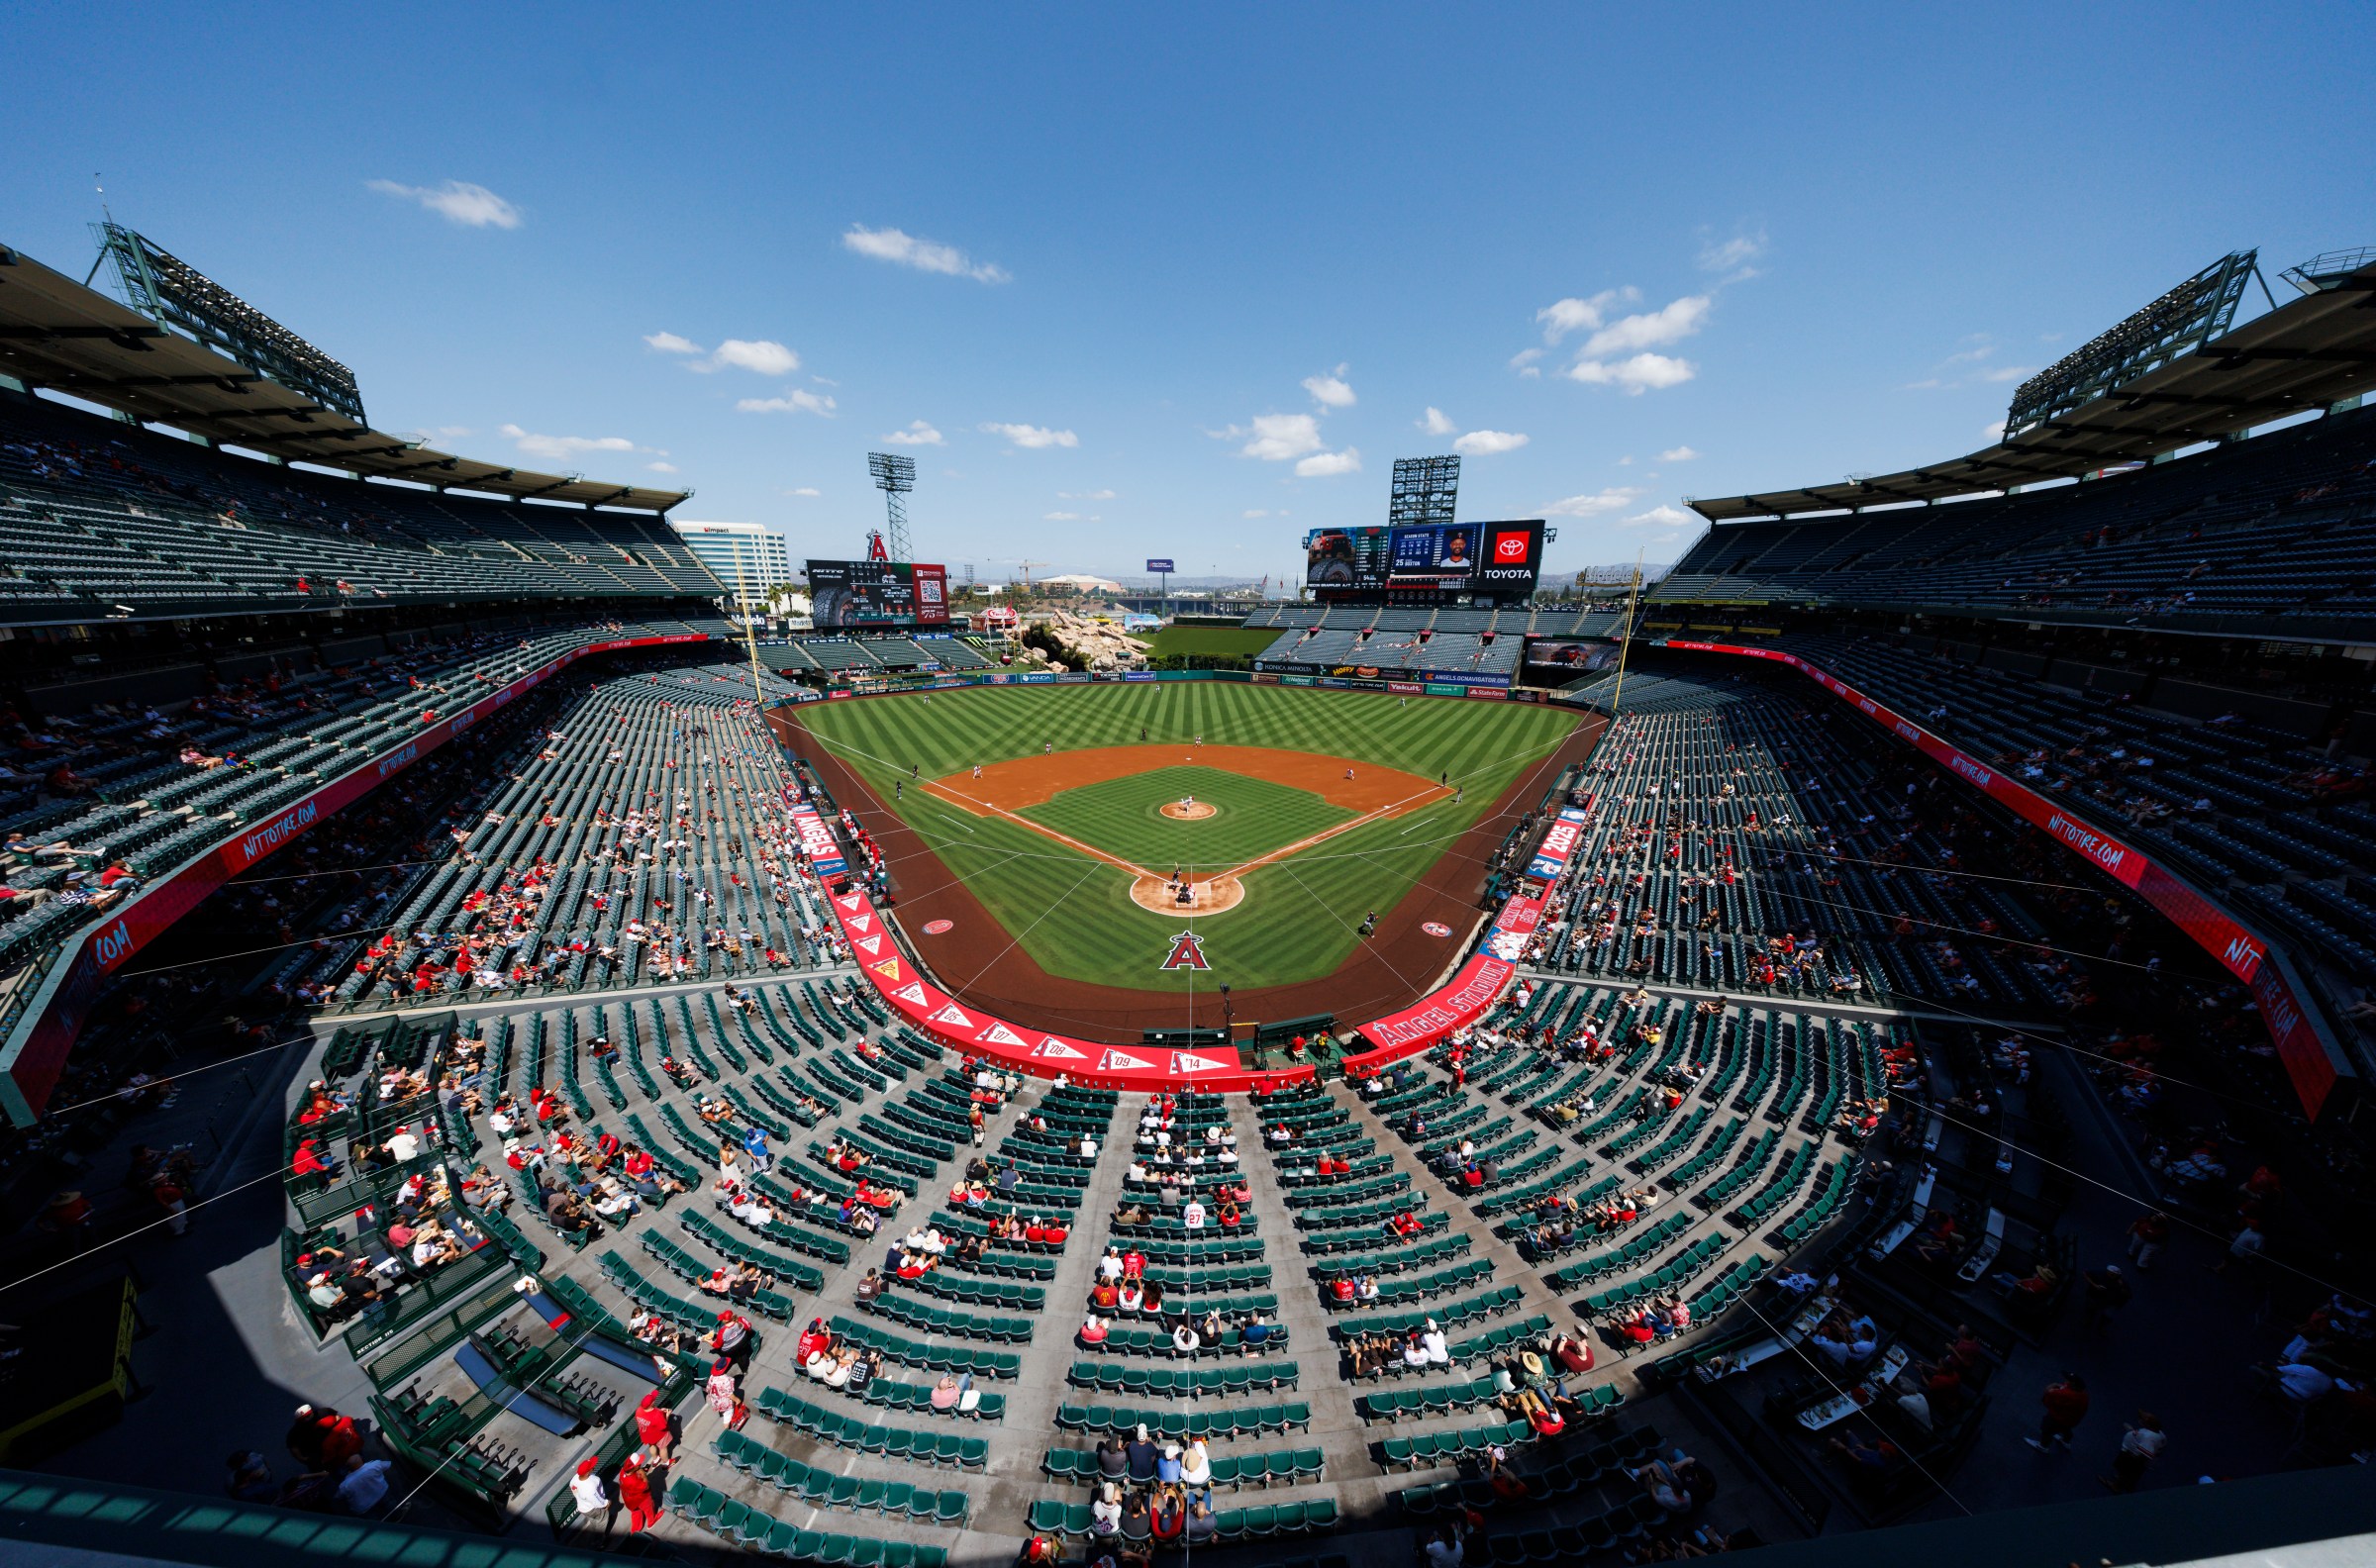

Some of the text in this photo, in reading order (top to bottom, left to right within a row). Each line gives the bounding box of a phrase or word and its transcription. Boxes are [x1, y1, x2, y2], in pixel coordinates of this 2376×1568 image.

[1485, 570, 1532, 579] TOYOTA
[1333, 666, 1354, 676] HOFFY
[1435, 675, 1509, 684] ANGELS.OCNAVIGATOR.ORG
[378, 742, 417, 777] NITTOTIRE.COM
[1952, 754, 1990, 789] NITTOTIRE.COM
[243, 800, 318, 861] NITTOTIRE.COM
[795, 816, 836, 856] ANGELS
[1543, 825, 1576, 853] 2025
[2048, 812, 2125, 872] NITTOTIRE.COM
[1447, 960, 1508, 1012] STADIUM
[944, 1010, 960, 1022] '05
[1373, 1006, 1458, 1047] ANGEL
[994, 1030, 1010, 1041] '07
[1049, 1045, 1066, 1056] '08
[1114, 1056, 1131, 1066] '09
[1186, 1058, 1200, 1068] '14
[1190, 1214, 1200, 1224] 27
[357, 1336, 383, 1355] SECTION
[798, 1343, 811, 1357] 27
